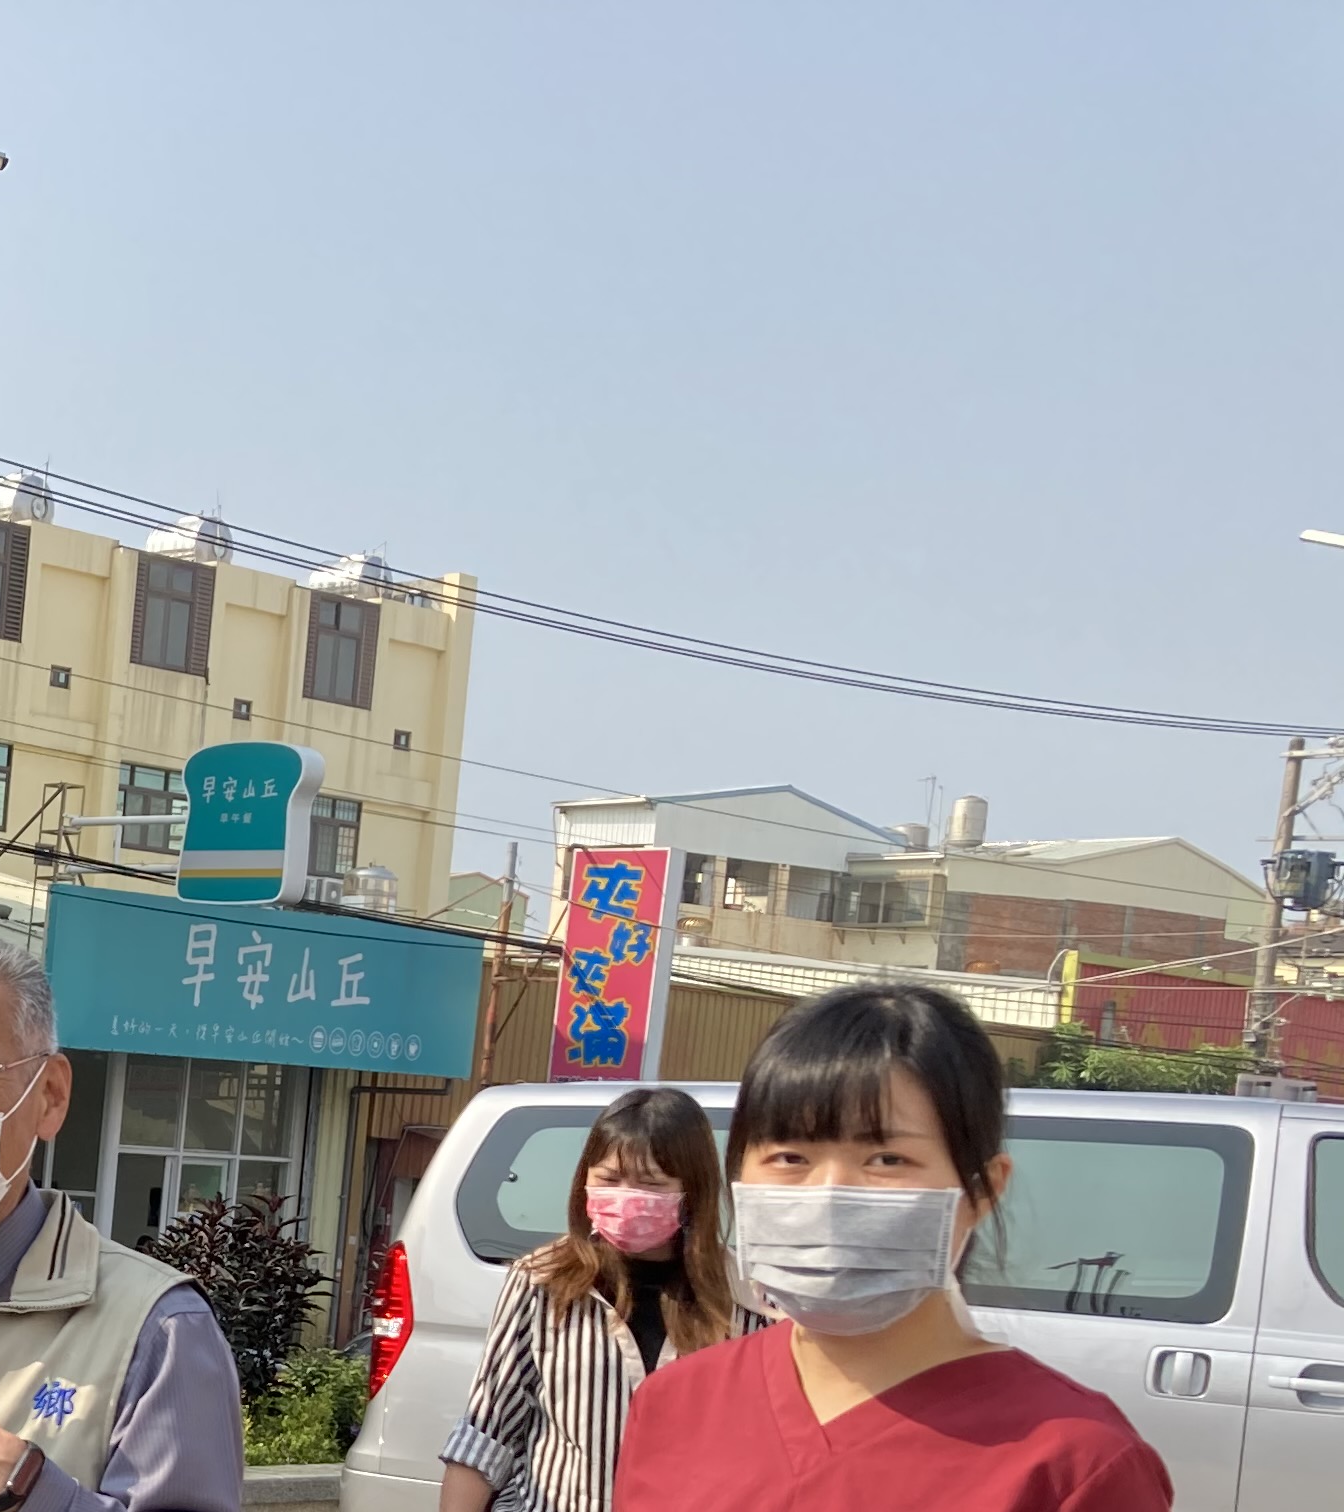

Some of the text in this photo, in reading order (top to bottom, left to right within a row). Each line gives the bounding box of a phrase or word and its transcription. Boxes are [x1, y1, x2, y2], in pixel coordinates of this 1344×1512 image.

[202, 776, 278, 803] 早安山丘
[182, 923, 371, 1009] 早安山丘
[33, 1381, 77, 1428] 鄉
